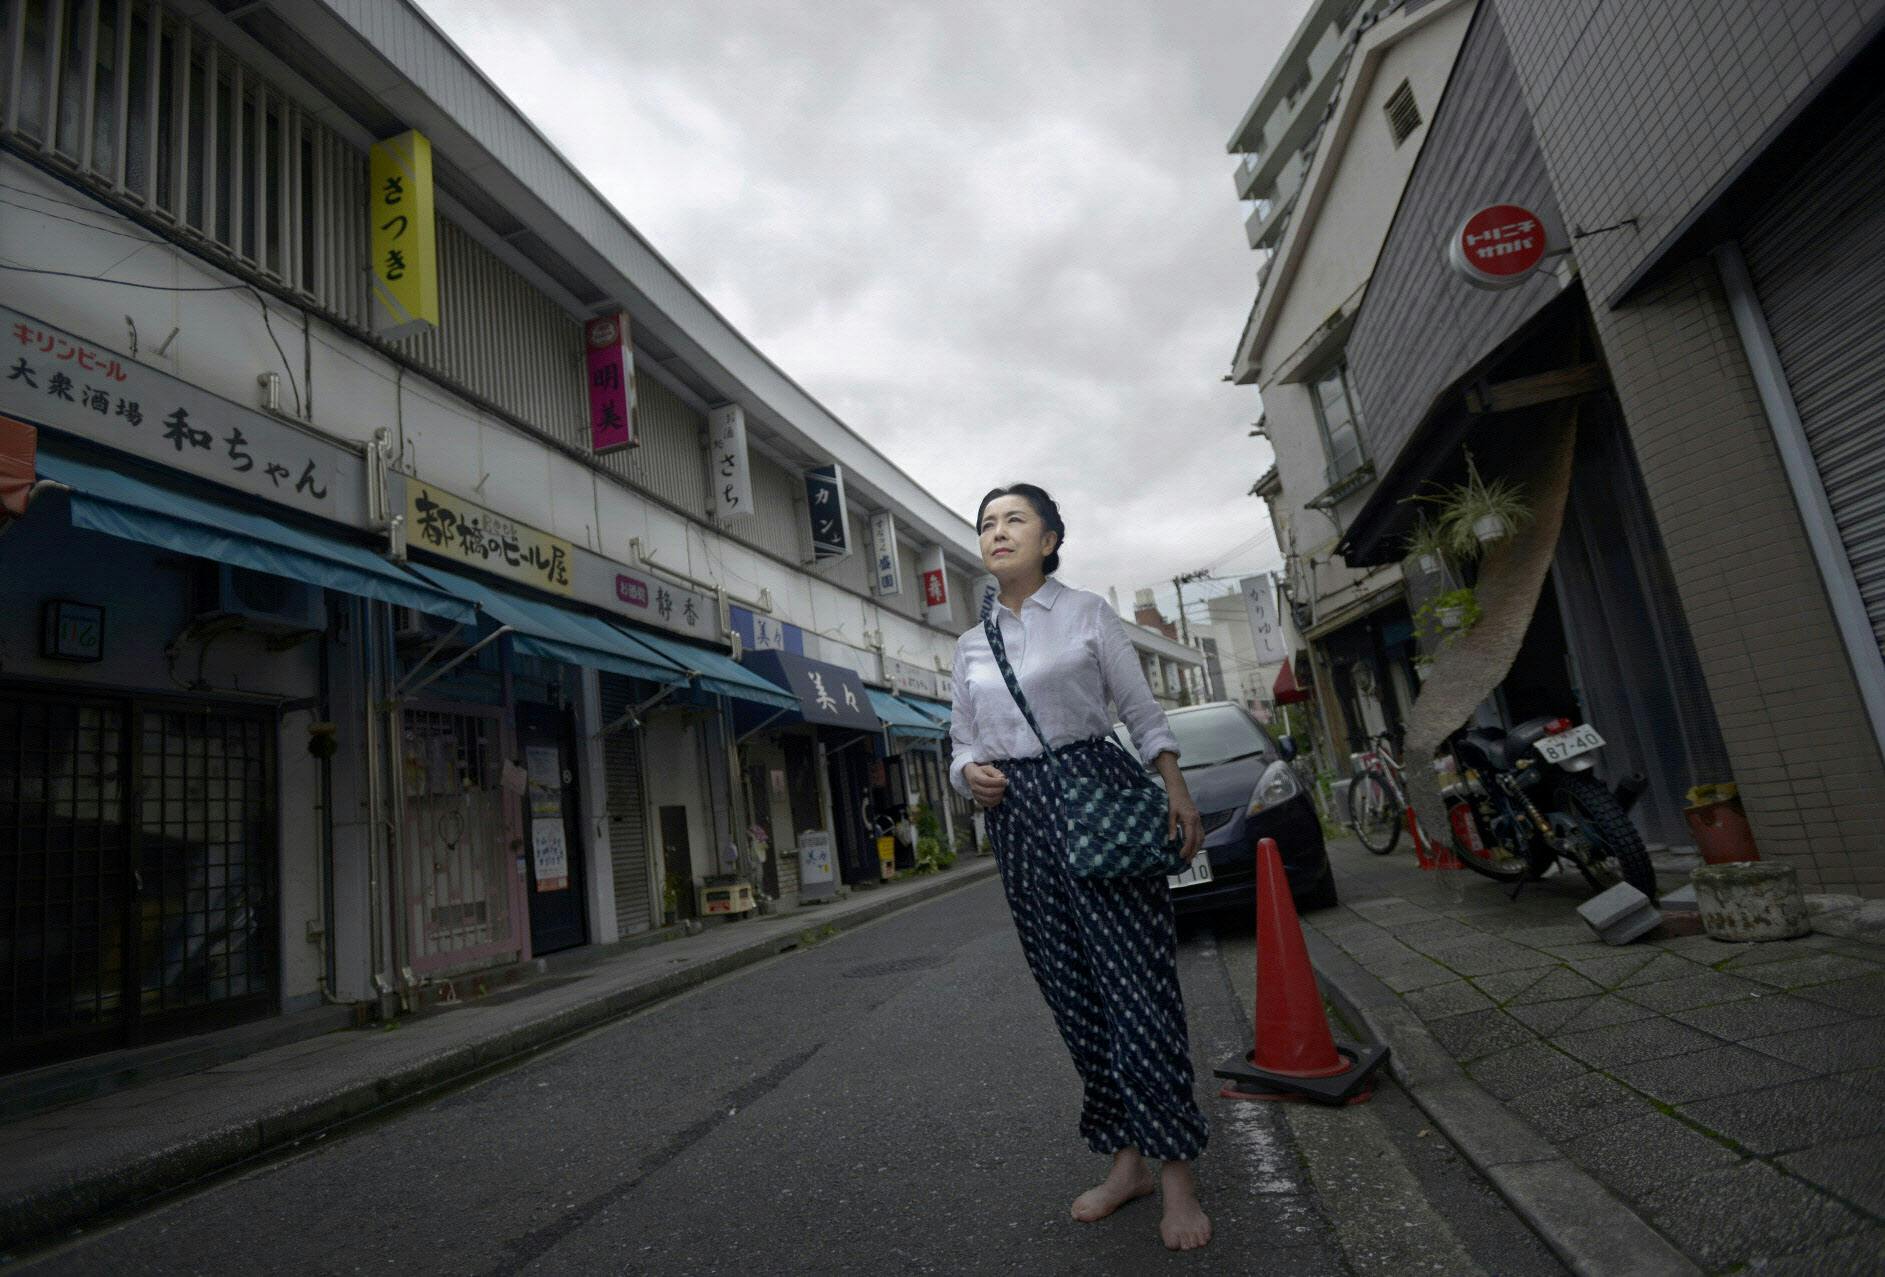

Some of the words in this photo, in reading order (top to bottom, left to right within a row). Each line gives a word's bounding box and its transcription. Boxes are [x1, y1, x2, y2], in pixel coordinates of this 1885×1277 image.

[381, 177, 408, 281] さつき
[13, 323, 128, 382] キリンビール
[6, 357, 144, 426] 大衆酒場
[594, 363, 622, 430] 明美
[162, 407, 328, 499] 和ちゃん
[720, 454, 738, 507] さち
[414, 490, 568, 586] 都橋のビール屋
[1546, 733, 1599, 760] 87-40
